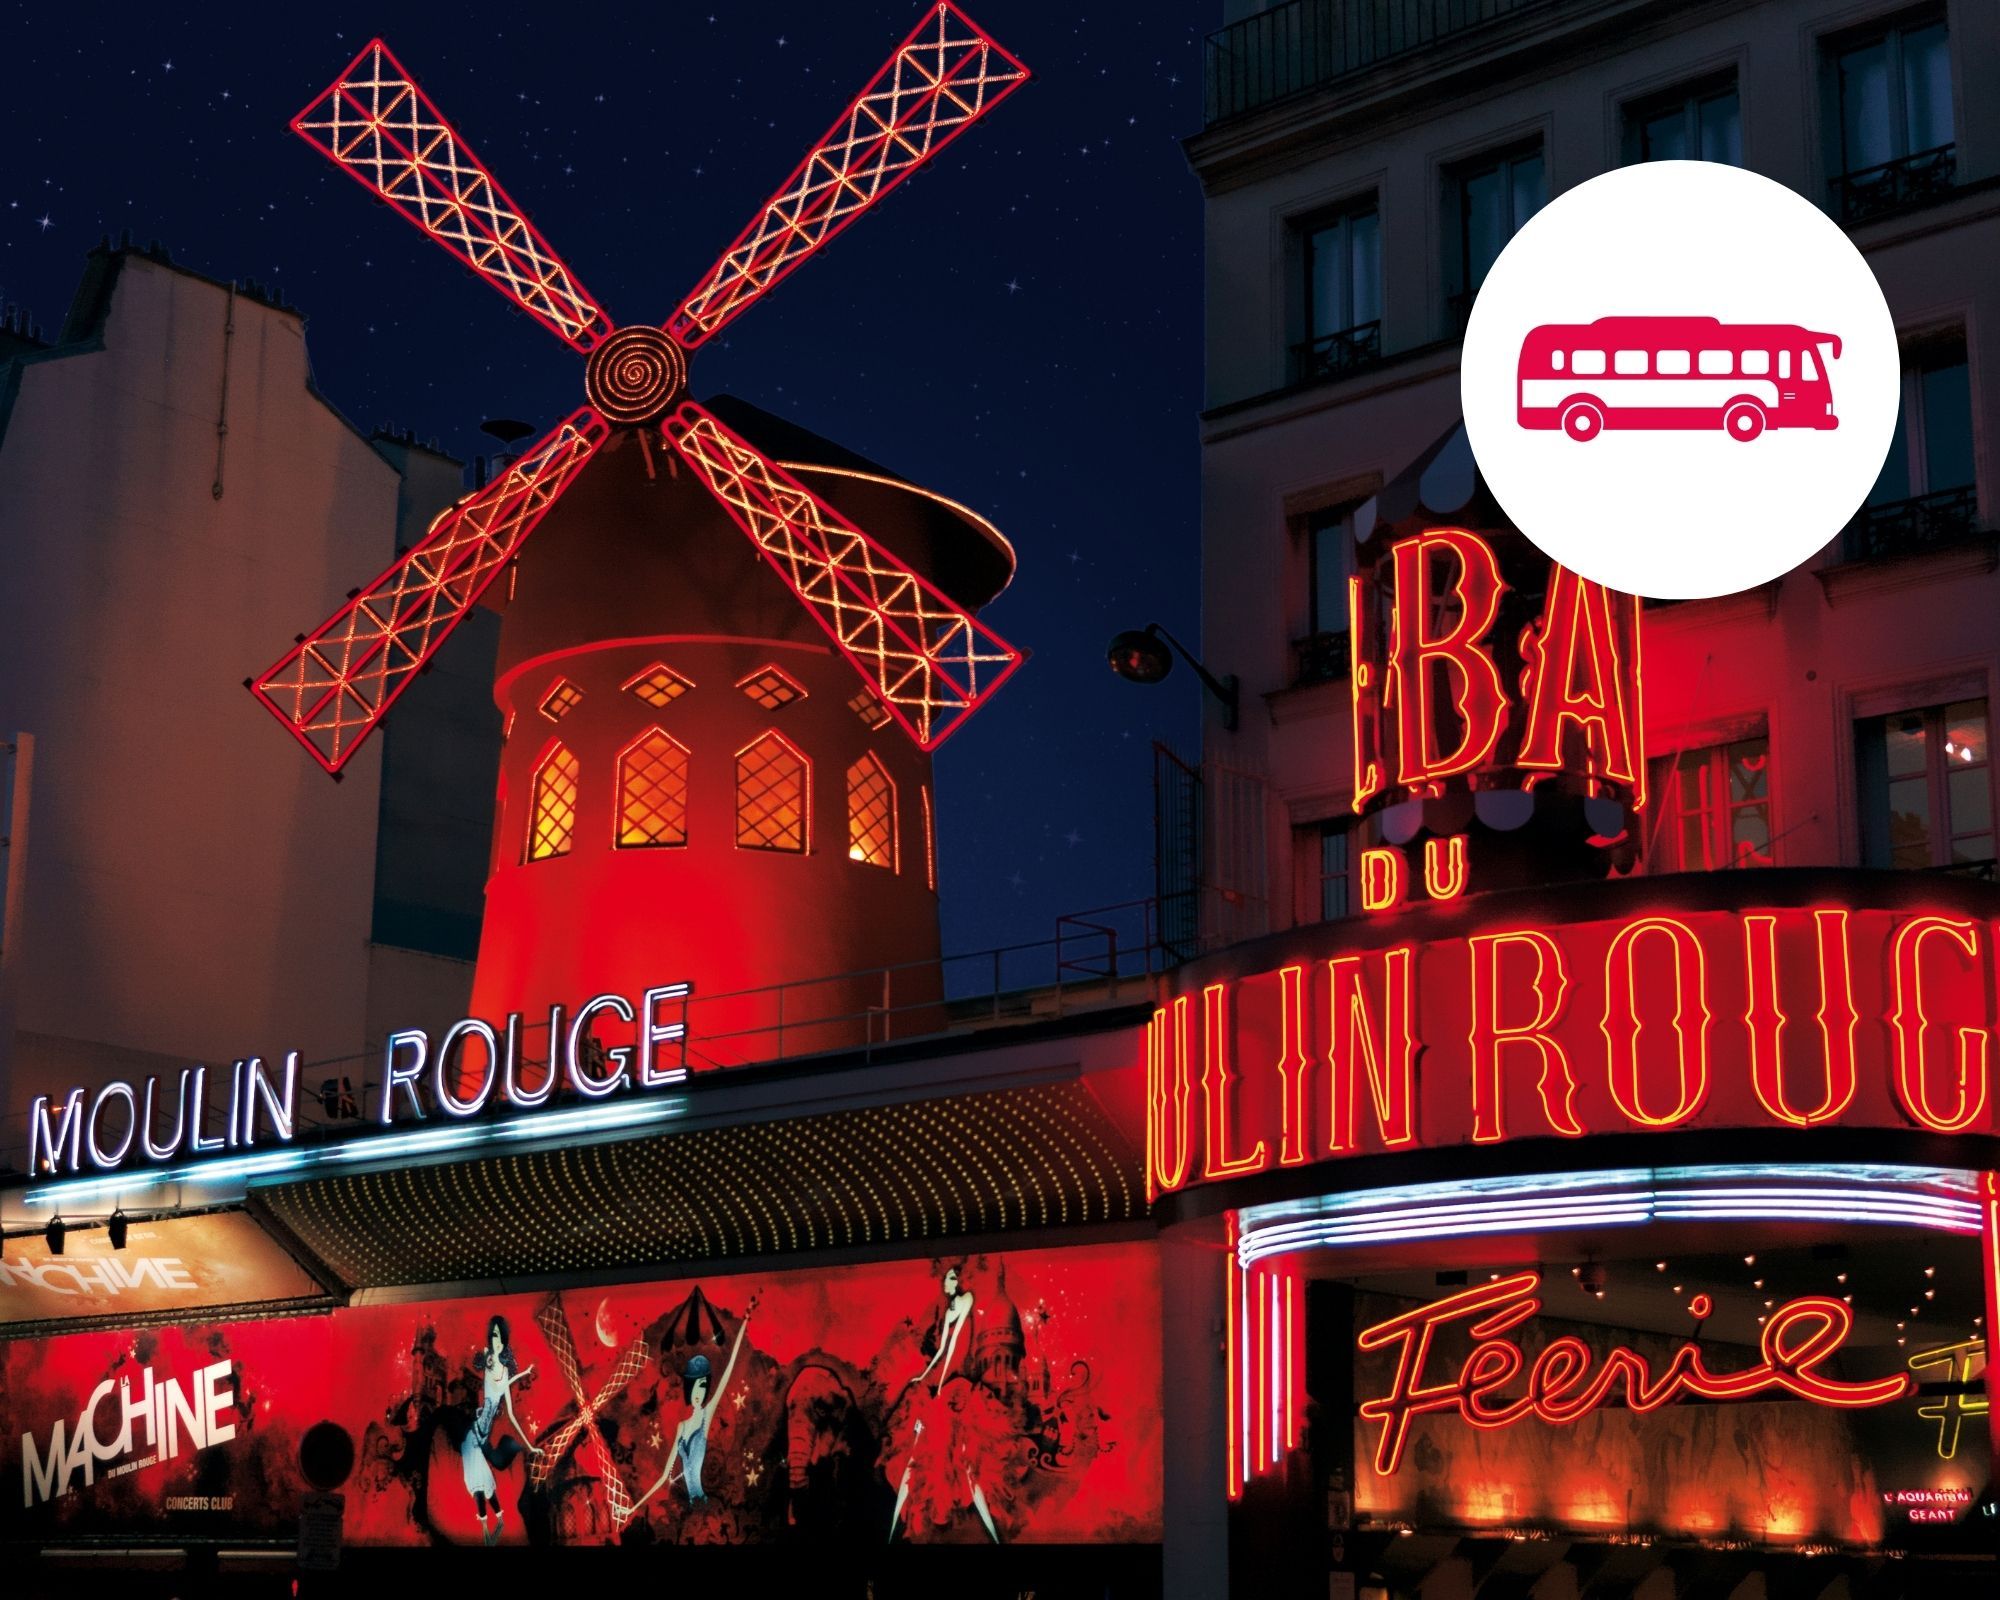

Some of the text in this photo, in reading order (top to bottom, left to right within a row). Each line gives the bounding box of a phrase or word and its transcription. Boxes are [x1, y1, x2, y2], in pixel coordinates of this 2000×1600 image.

[1361, 837, 1465, 911] DU
[28, 982, 692, 1179] MOULIN ROUGE
[1146, 909, 2000, 1201] ULIN ROUG
[120, 1375, 130, 1387] LA
[1359, 1271, 1909, 1476] Féerie
[21, 1359, 236, 1508] MACHINE
[108, 1455, 157, 1479] DU MOULIN ROUGE
[166, 1496, 233, 1510] CONCERTS CLUB
[1909, 1509, 1955, 1520] GEANT
